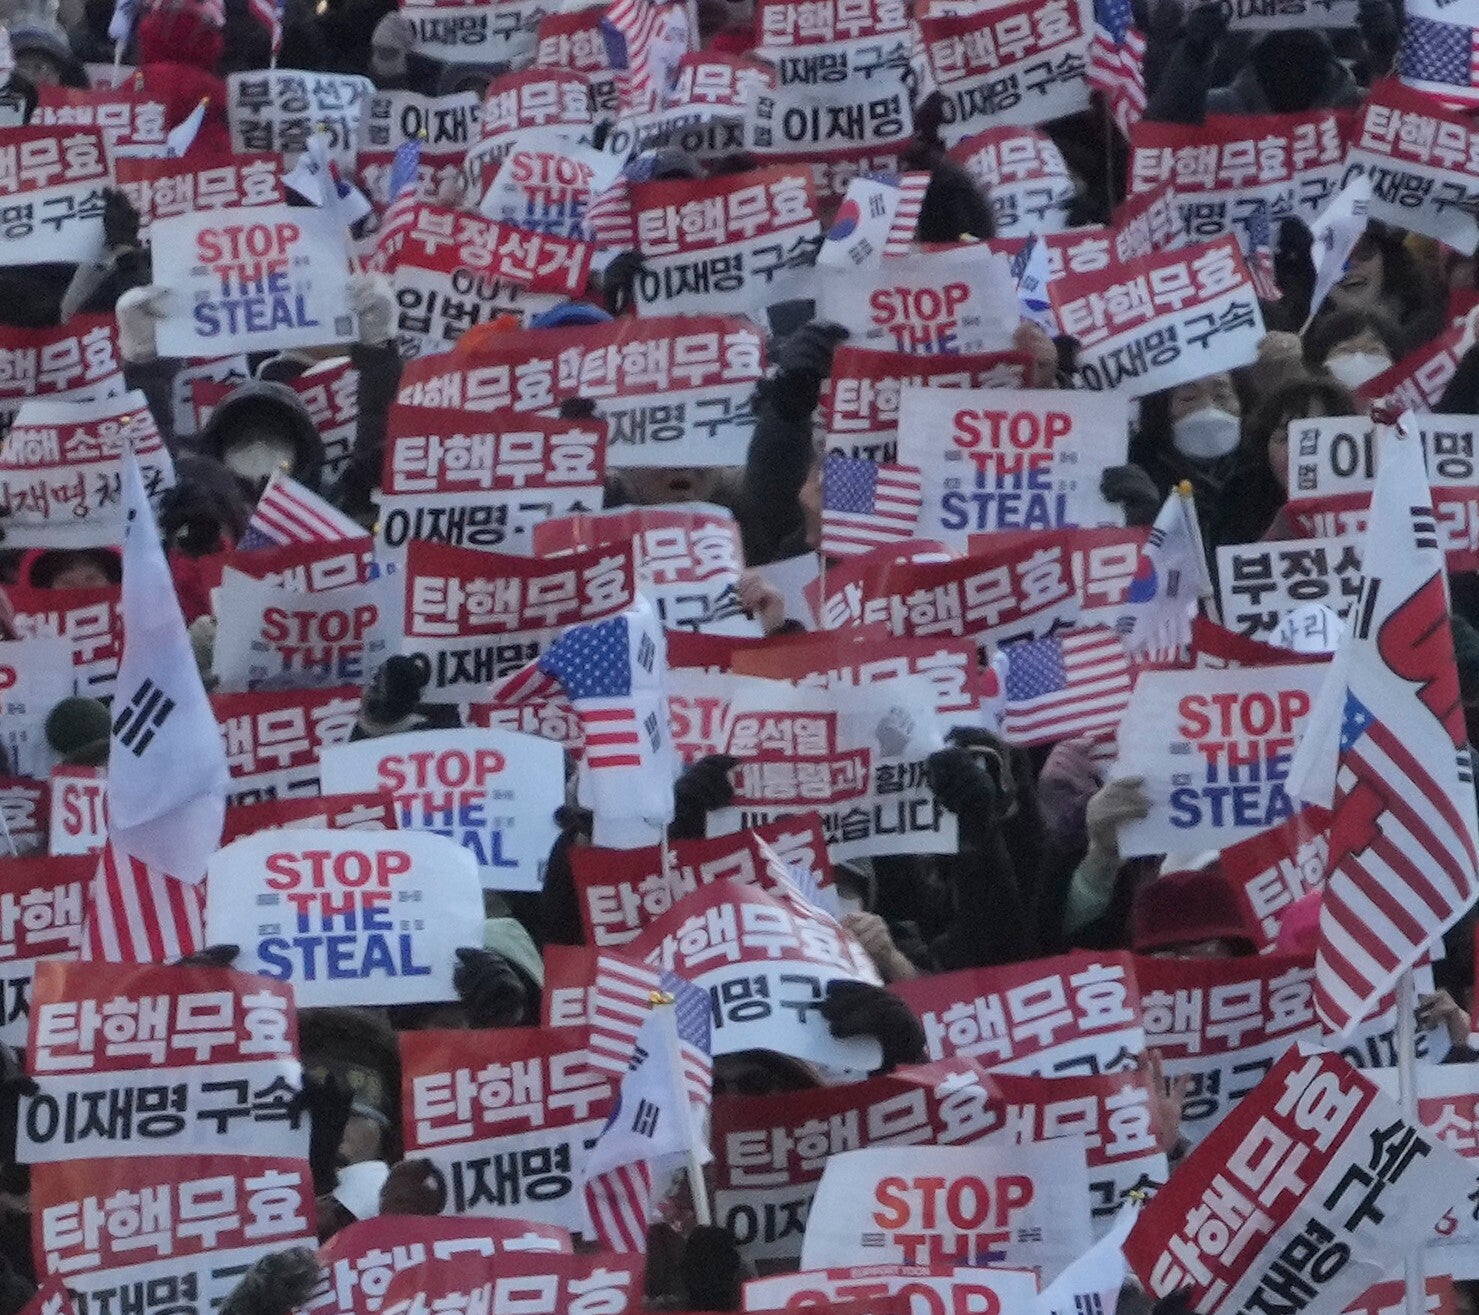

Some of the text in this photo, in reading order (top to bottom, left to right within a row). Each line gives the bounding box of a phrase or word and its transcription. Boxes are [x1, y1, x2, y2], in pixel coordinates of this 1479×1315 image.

[639, 176, 818, 252] 탄핵무효
[197, 224, 301, 262] STOP
[213, 262, 291, 295] THE
[194, 295, 319, 336] STEAL
[1060, 258, 1243, 348] 탄핵무효
[392, 428, 607, 494] 탄핵무효
[265, 849, 412, 890] STOP
[295, 890, 394, 935] THE
[258, 935, 431, 980] STEAL
[35, 985, 295, 1074] 탄핵무효
[43, 1171, 312, 1274] 탄핵무효
